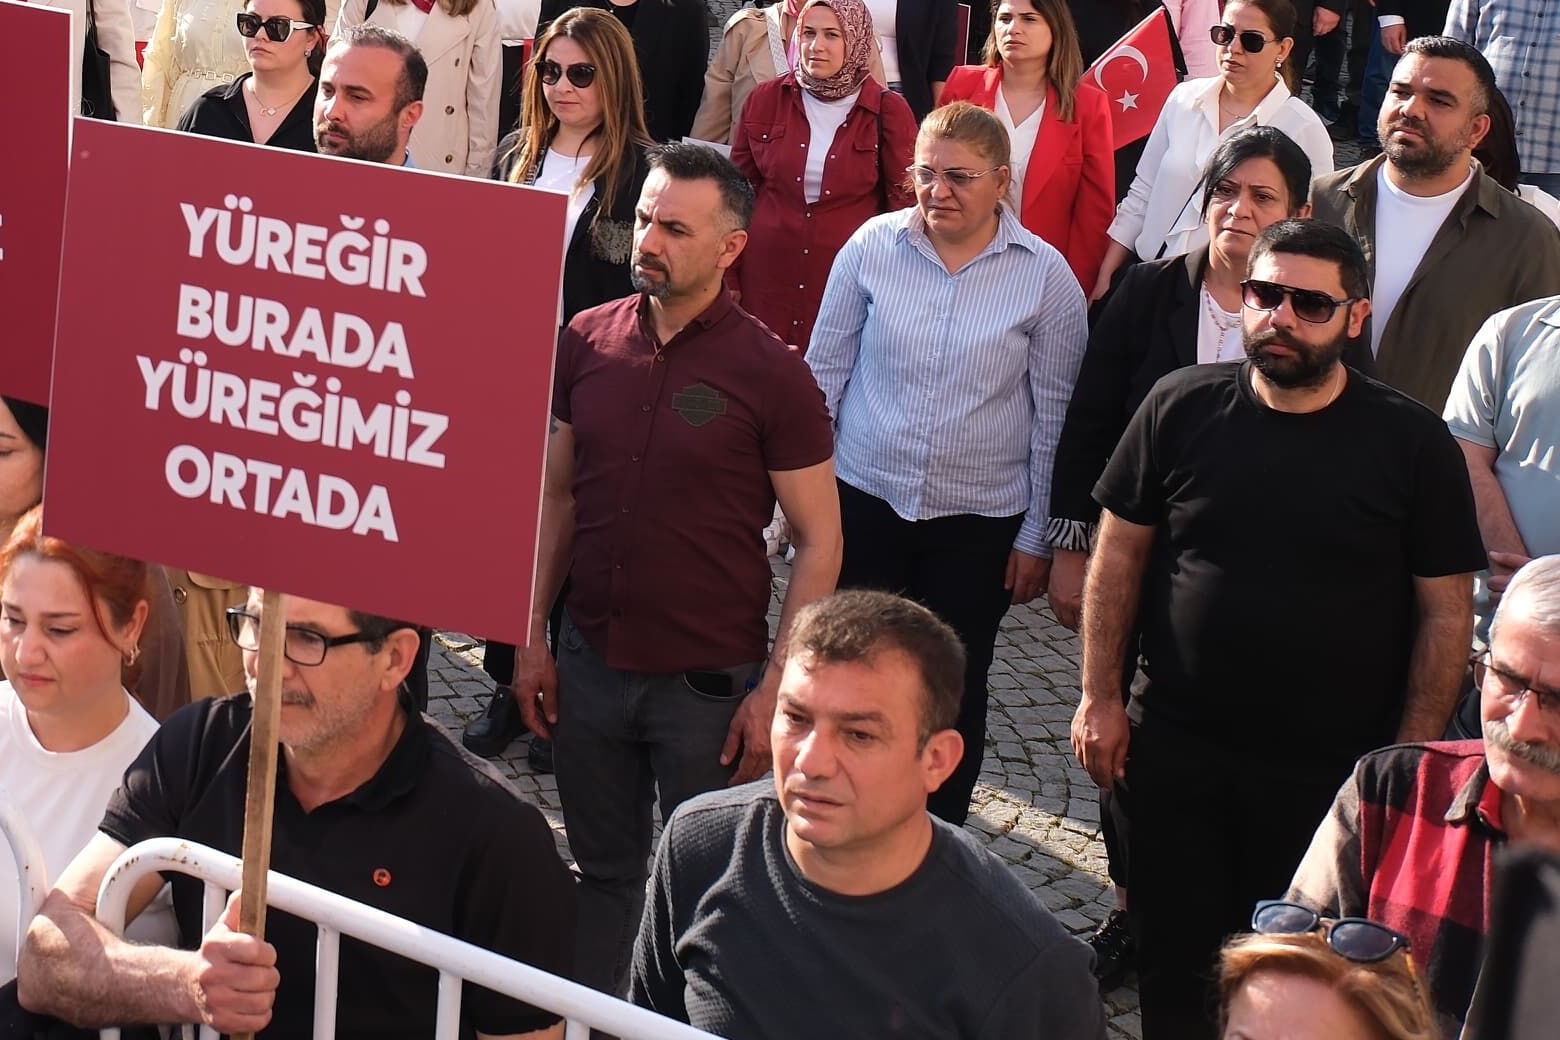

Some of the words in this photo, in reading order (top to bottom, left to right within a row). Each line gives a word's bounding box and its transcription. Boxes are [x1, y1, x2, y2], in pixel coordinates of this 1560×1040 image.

[179, 193, 429, 298] YÜREĞİR
[176, 283, 416, 380] BURADA
[136, 347, 450, 469] YÜREĞİMİZ
[165, 444, 400, 543] ORTADA
